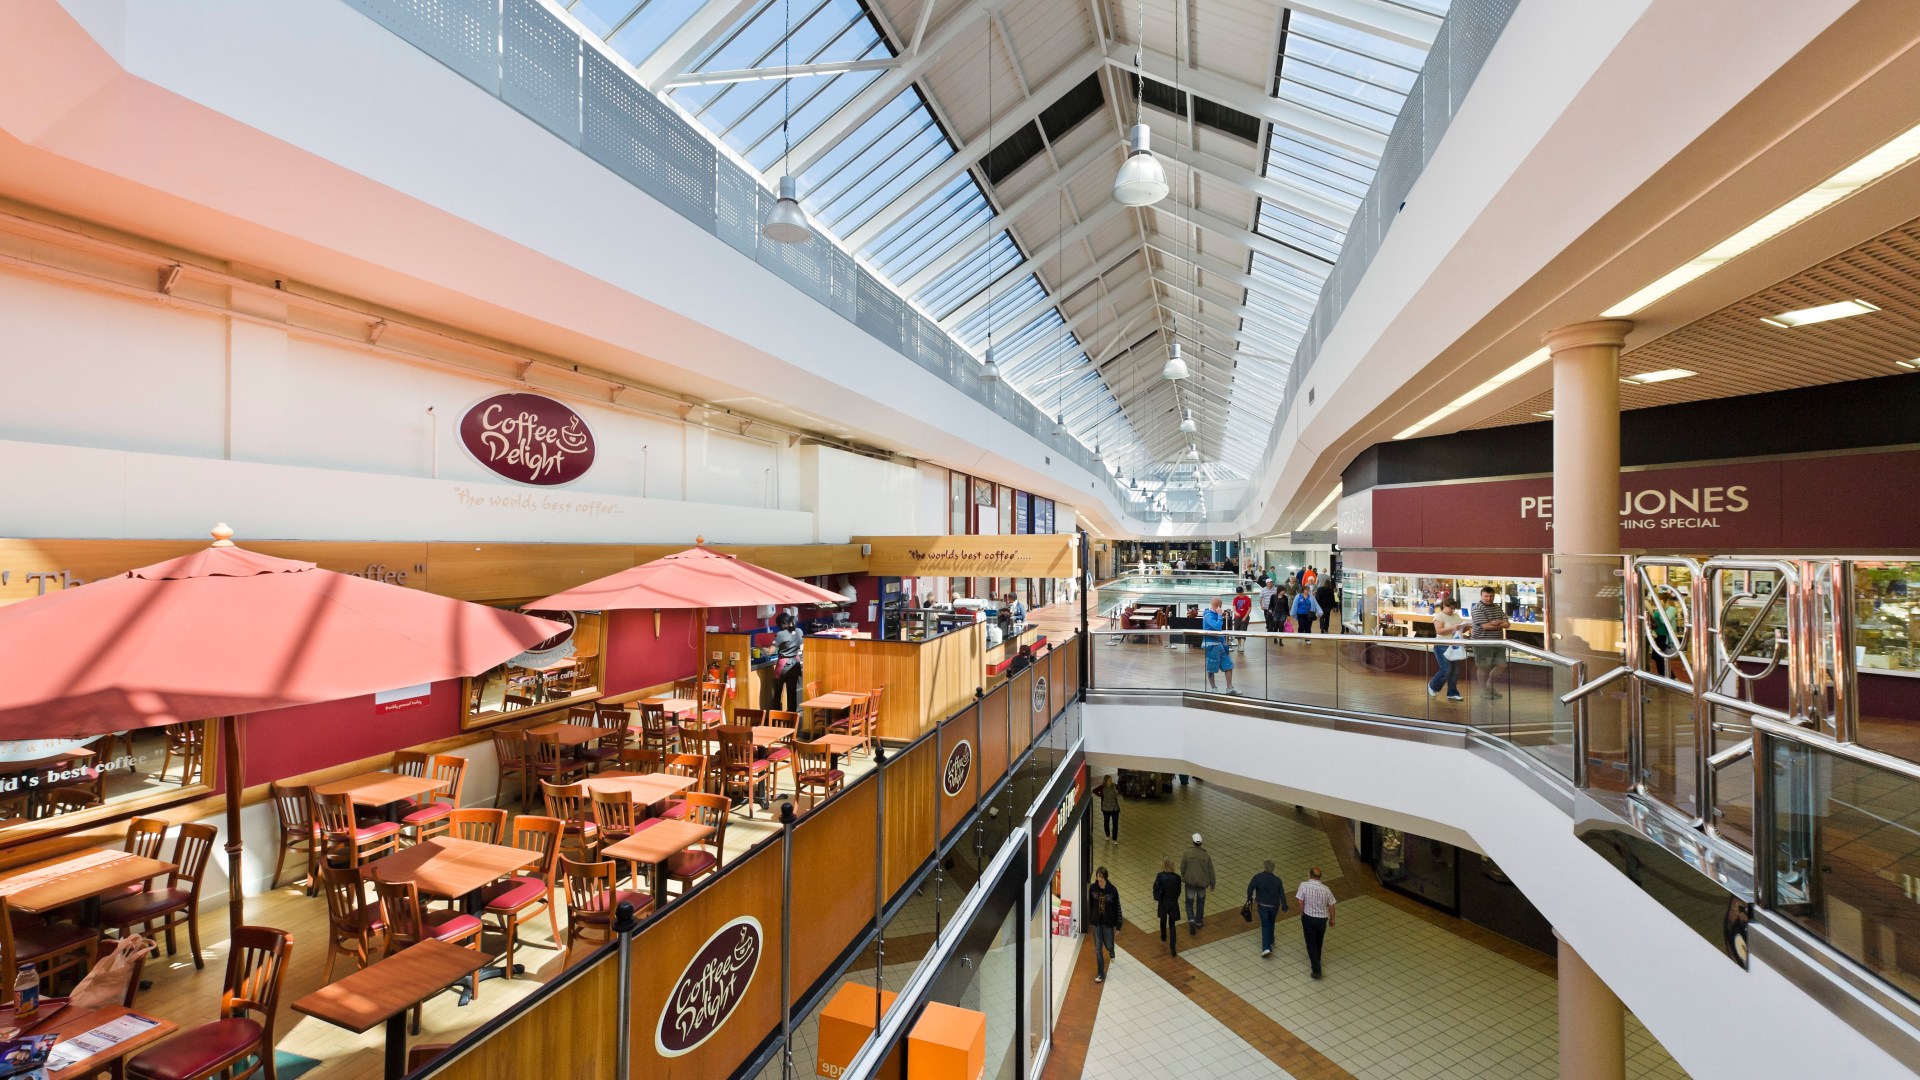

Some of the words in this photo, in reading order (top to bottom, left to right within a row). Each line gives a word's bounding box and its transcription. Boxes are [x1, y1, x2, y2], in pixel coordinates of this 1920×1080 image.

[482, 404, 558, 444] Coffee
[481, 431, 565, 480] Delight
[489, 493, 537, 511] worlds
[543, 495, 570, 514] best
[1619, 485, 1749, 516] JONES
[1619, 519, 1656, 530] HING
[1660, 517, 1720, 529] SPECIAL
[928, 549, 958, 560] worlds
[961, 549, 982, 561] best
[26, 569, 104, 596] Th
[343, 563, 408, 585] ffee
[518, 673, 542, 687] orld's
[0, 775, 40, 793] ld's
[47, 764, 88, 784] best
[95, 755, 148, 773] coffee
[676, 955, 734, 1015] Coffee
[675, 973, 737, 1042] Delight
